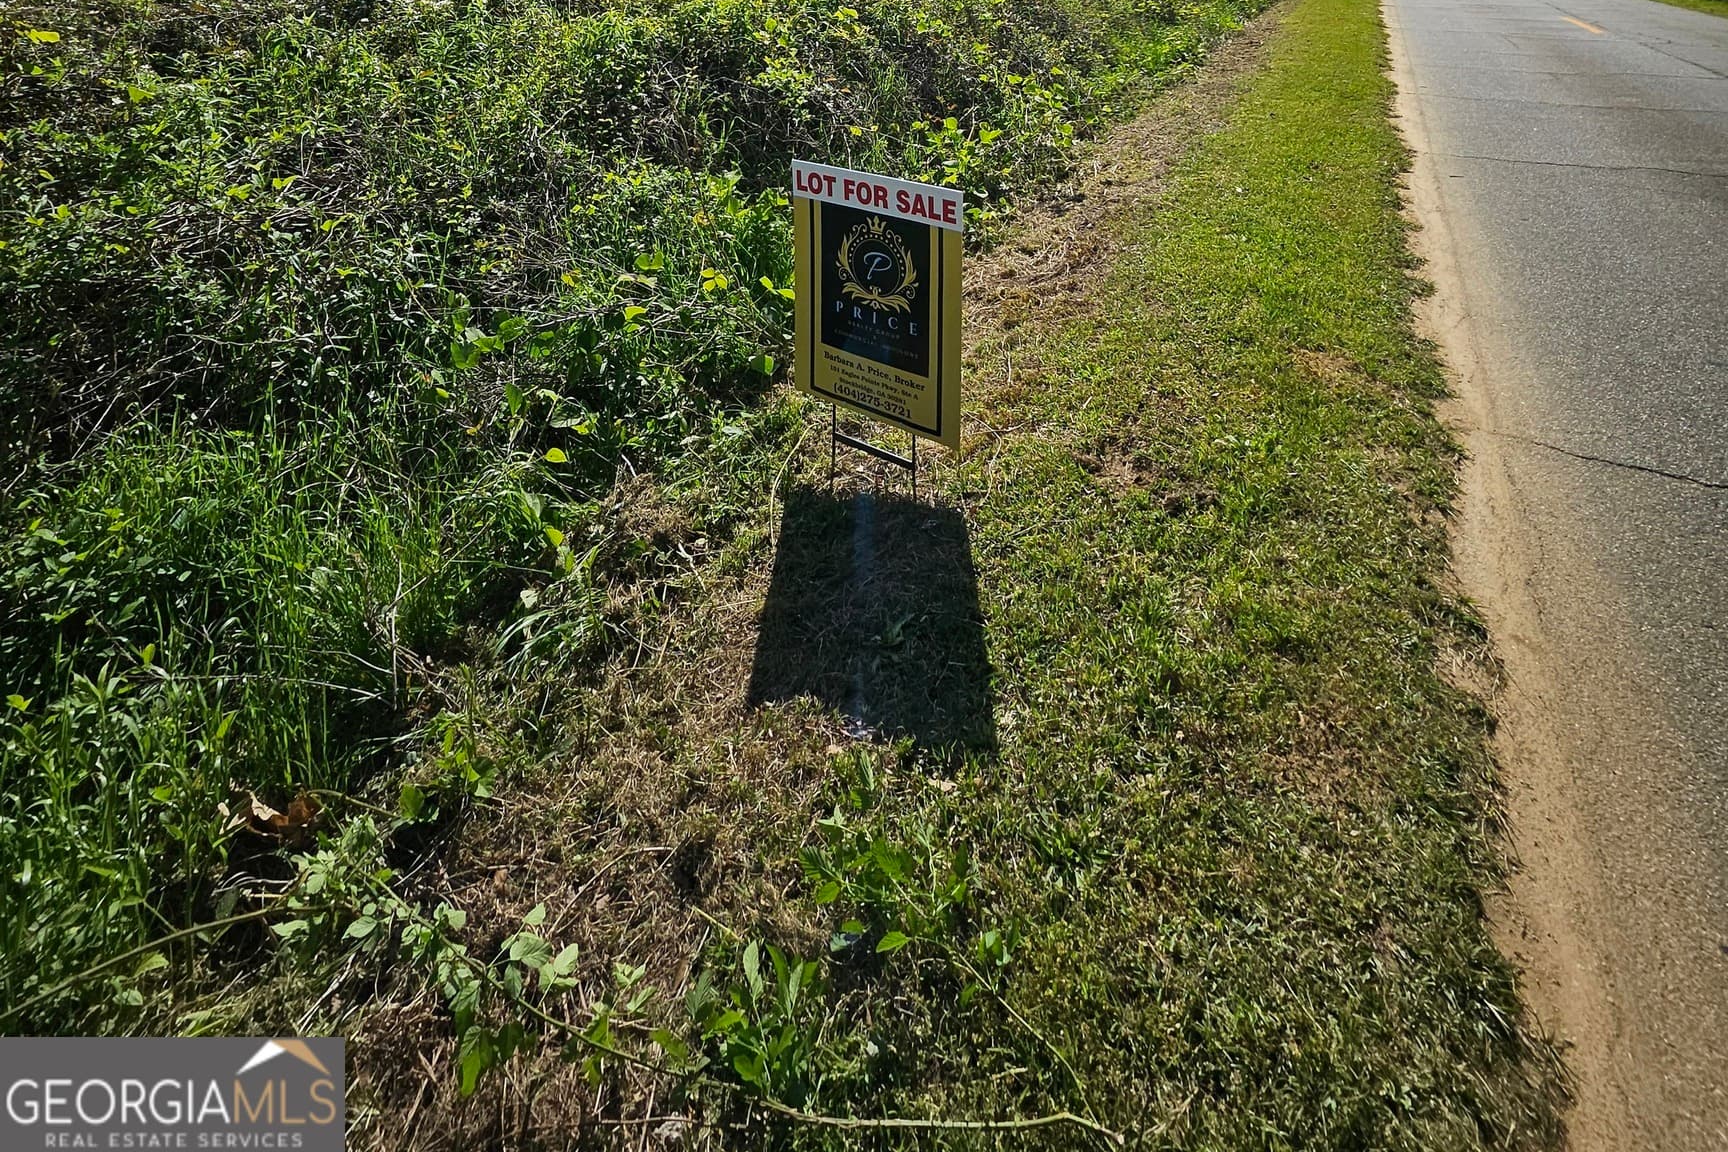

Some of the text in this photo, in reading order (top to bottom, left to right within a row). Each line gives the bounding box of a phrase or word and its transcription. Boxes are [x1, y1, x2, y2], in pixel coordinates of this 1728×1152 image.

[796, 169, 957, 225] LOT FOR SALE
[835, 300, 918, 336] PRICE
[823, 350, 926, 391] Barbara A. Price, Broker
[833, 382, 912, 418] (404)275-3721
